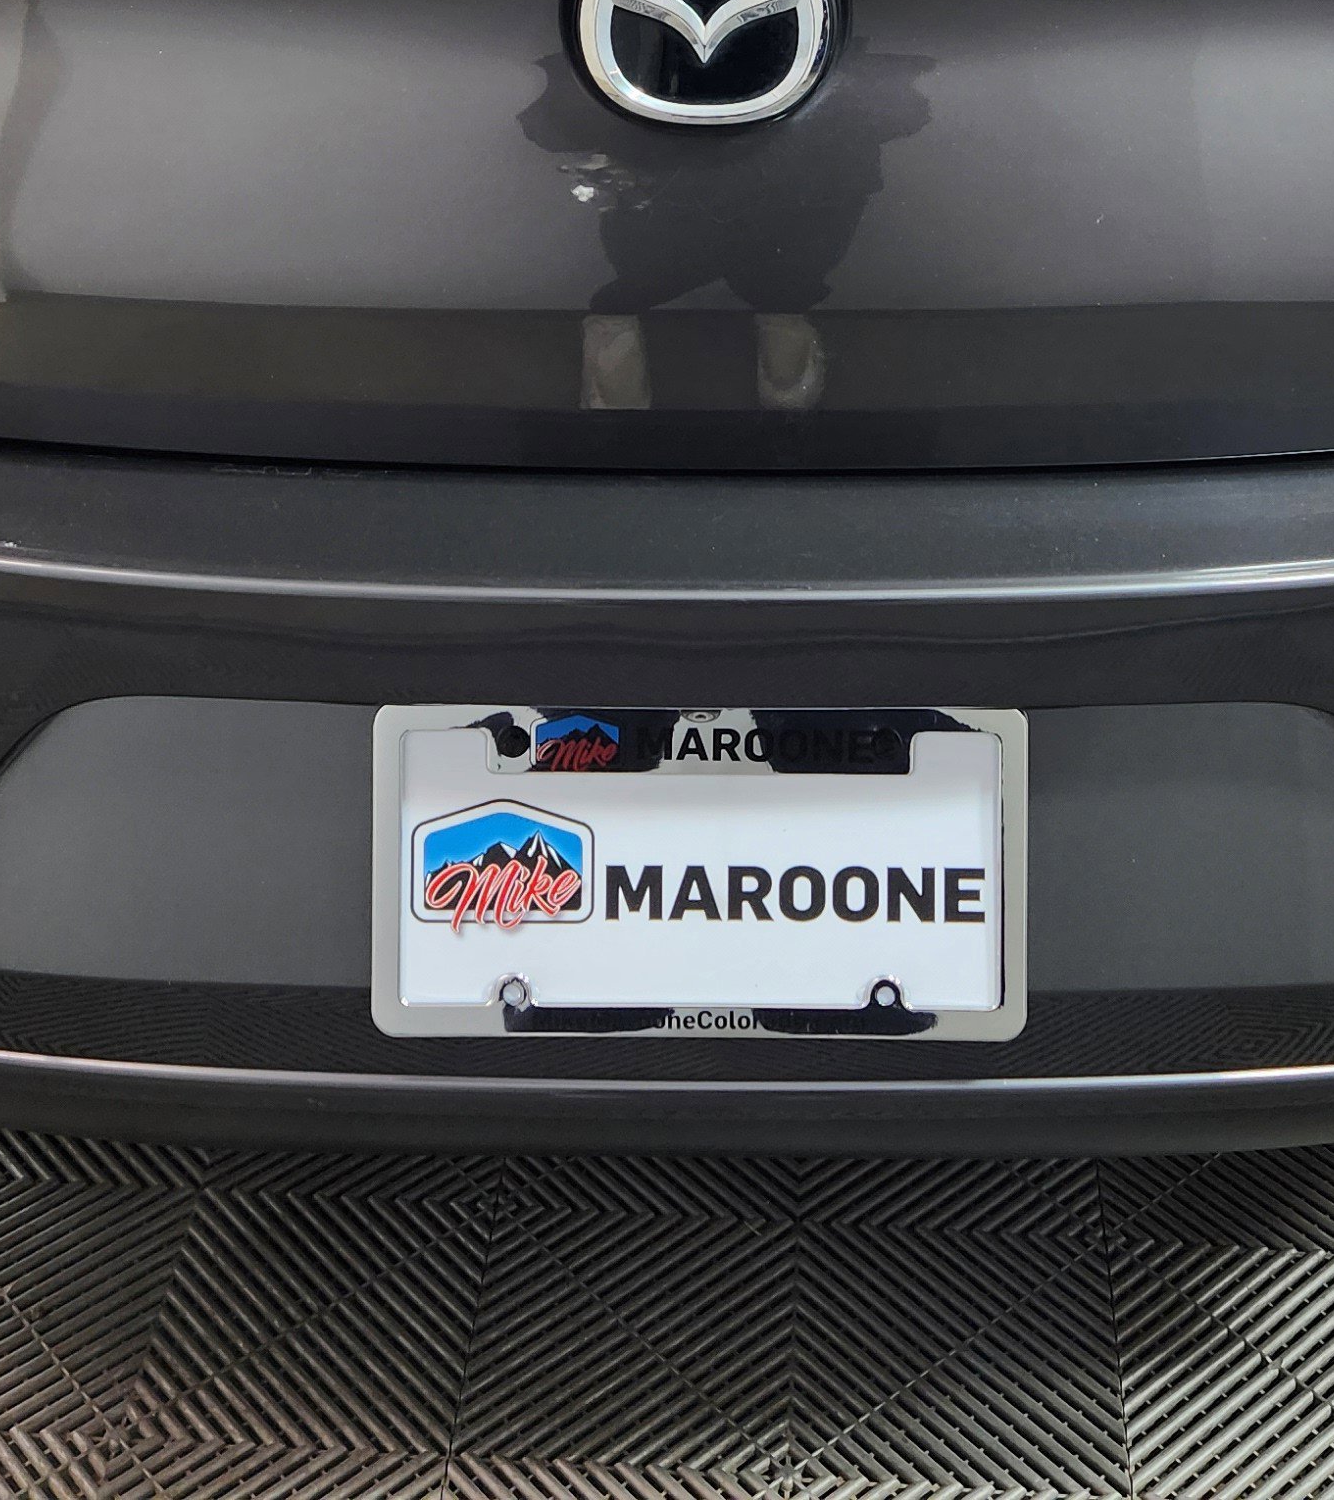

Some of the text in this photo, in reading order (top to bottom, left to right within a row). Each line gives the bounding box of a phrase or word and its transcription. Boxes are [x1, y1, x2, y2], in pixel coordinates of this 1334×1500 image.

[536, 736, 619, 772] Mike
[425, 854, 987, 934] Mike MAROONE
